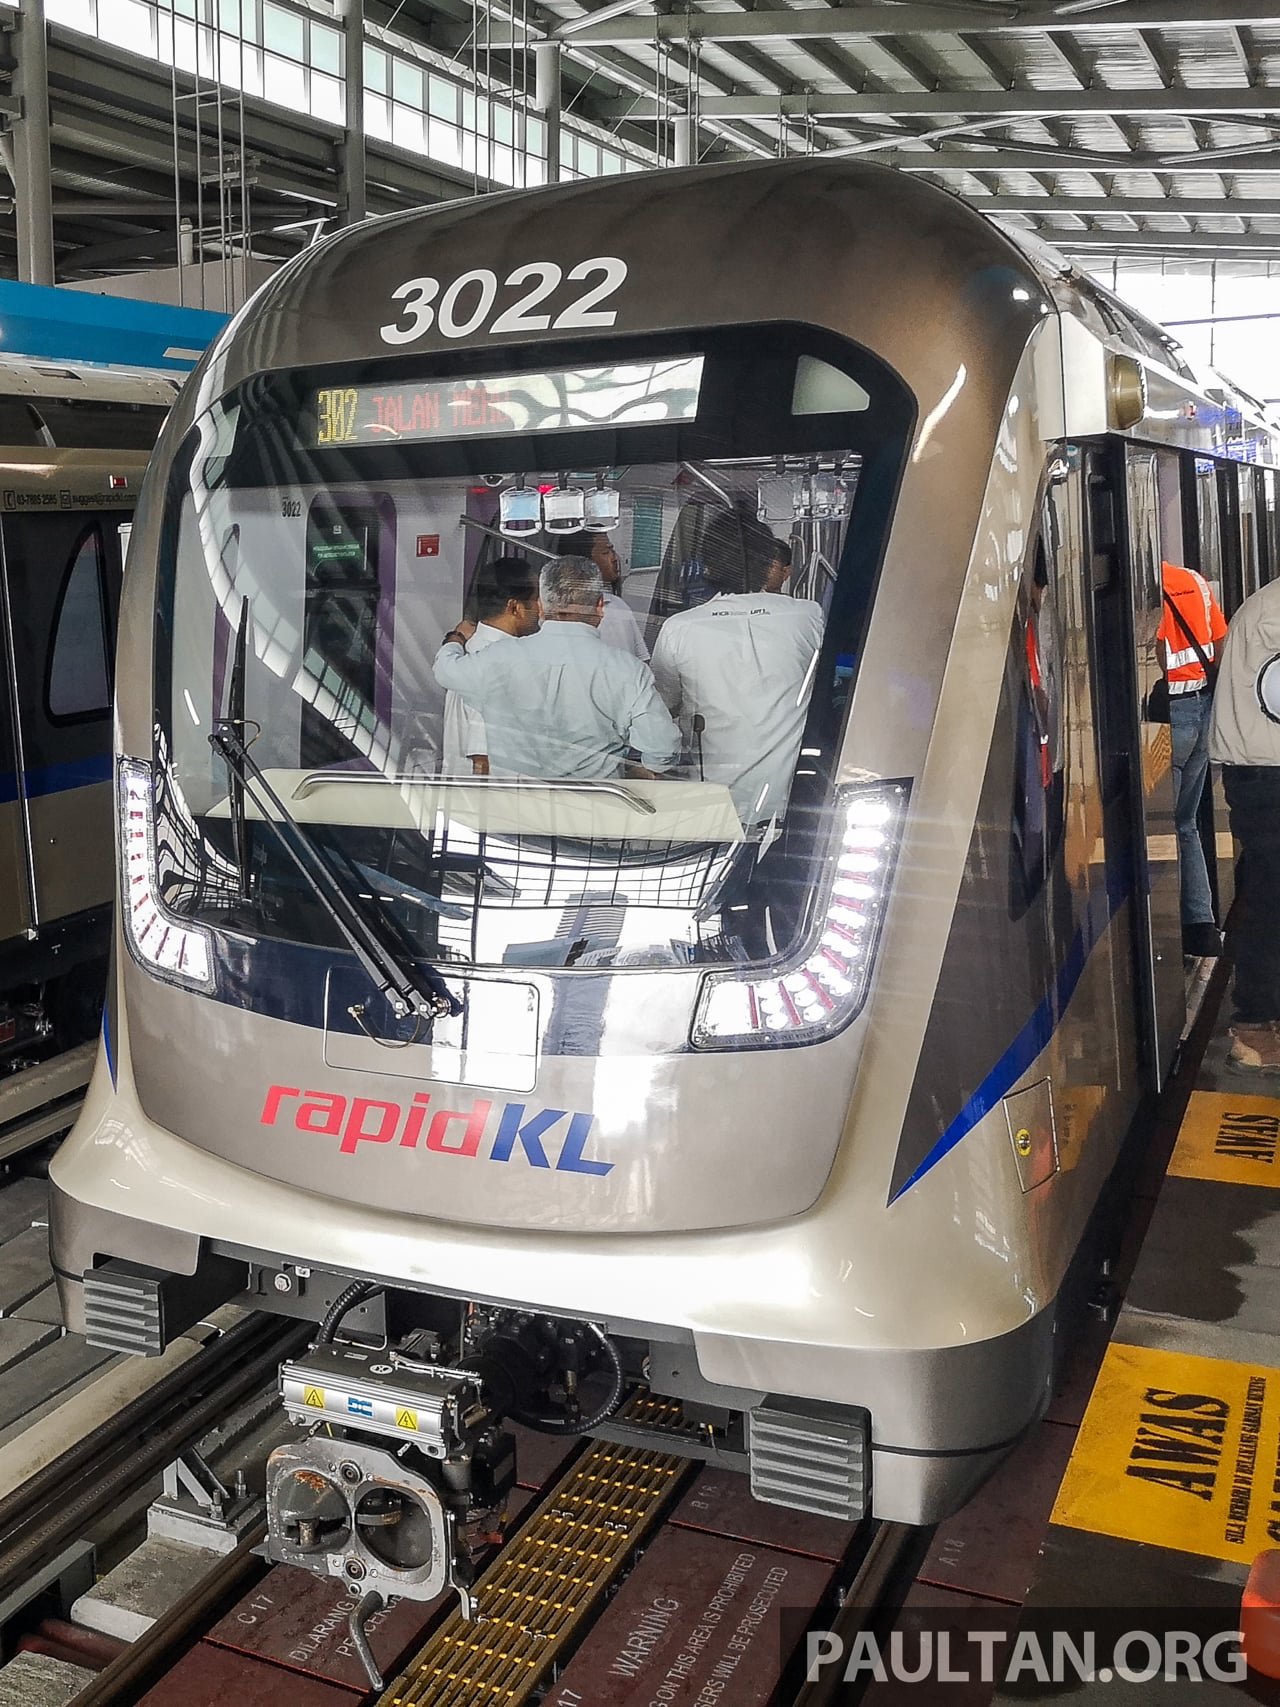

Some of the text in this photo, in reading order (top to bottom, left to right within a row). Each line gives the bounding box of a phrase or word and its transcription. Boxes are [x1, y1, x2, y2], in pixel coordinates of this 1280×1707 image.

[380, 256, 628, 345] 3022
[318, 388, 359, 442] 302
[371, 391, 440, 433] JALAN
[282, 501, 302, 518] 3022
[260, 1085, 616, 1177] rapidKL
[1214, 1111, 1280, 1164] AWAS
[1124, 1387, 1231, 1502] AWAS
[708, 1553, 757, 1612] PROHIBITED
[288, 1600, 355, 1662] DILARANG
[607, 1598, 680, 1677] WARNING
[685, 1624, 718, 1656] AREA
[702, 1611, 721, 1624] IS
[712, 1566, 789, 1679] WILL BE PROSECUTED
[656, 1680, 681, 1700] ON
[666, 1654, 697, 1680] THIS
